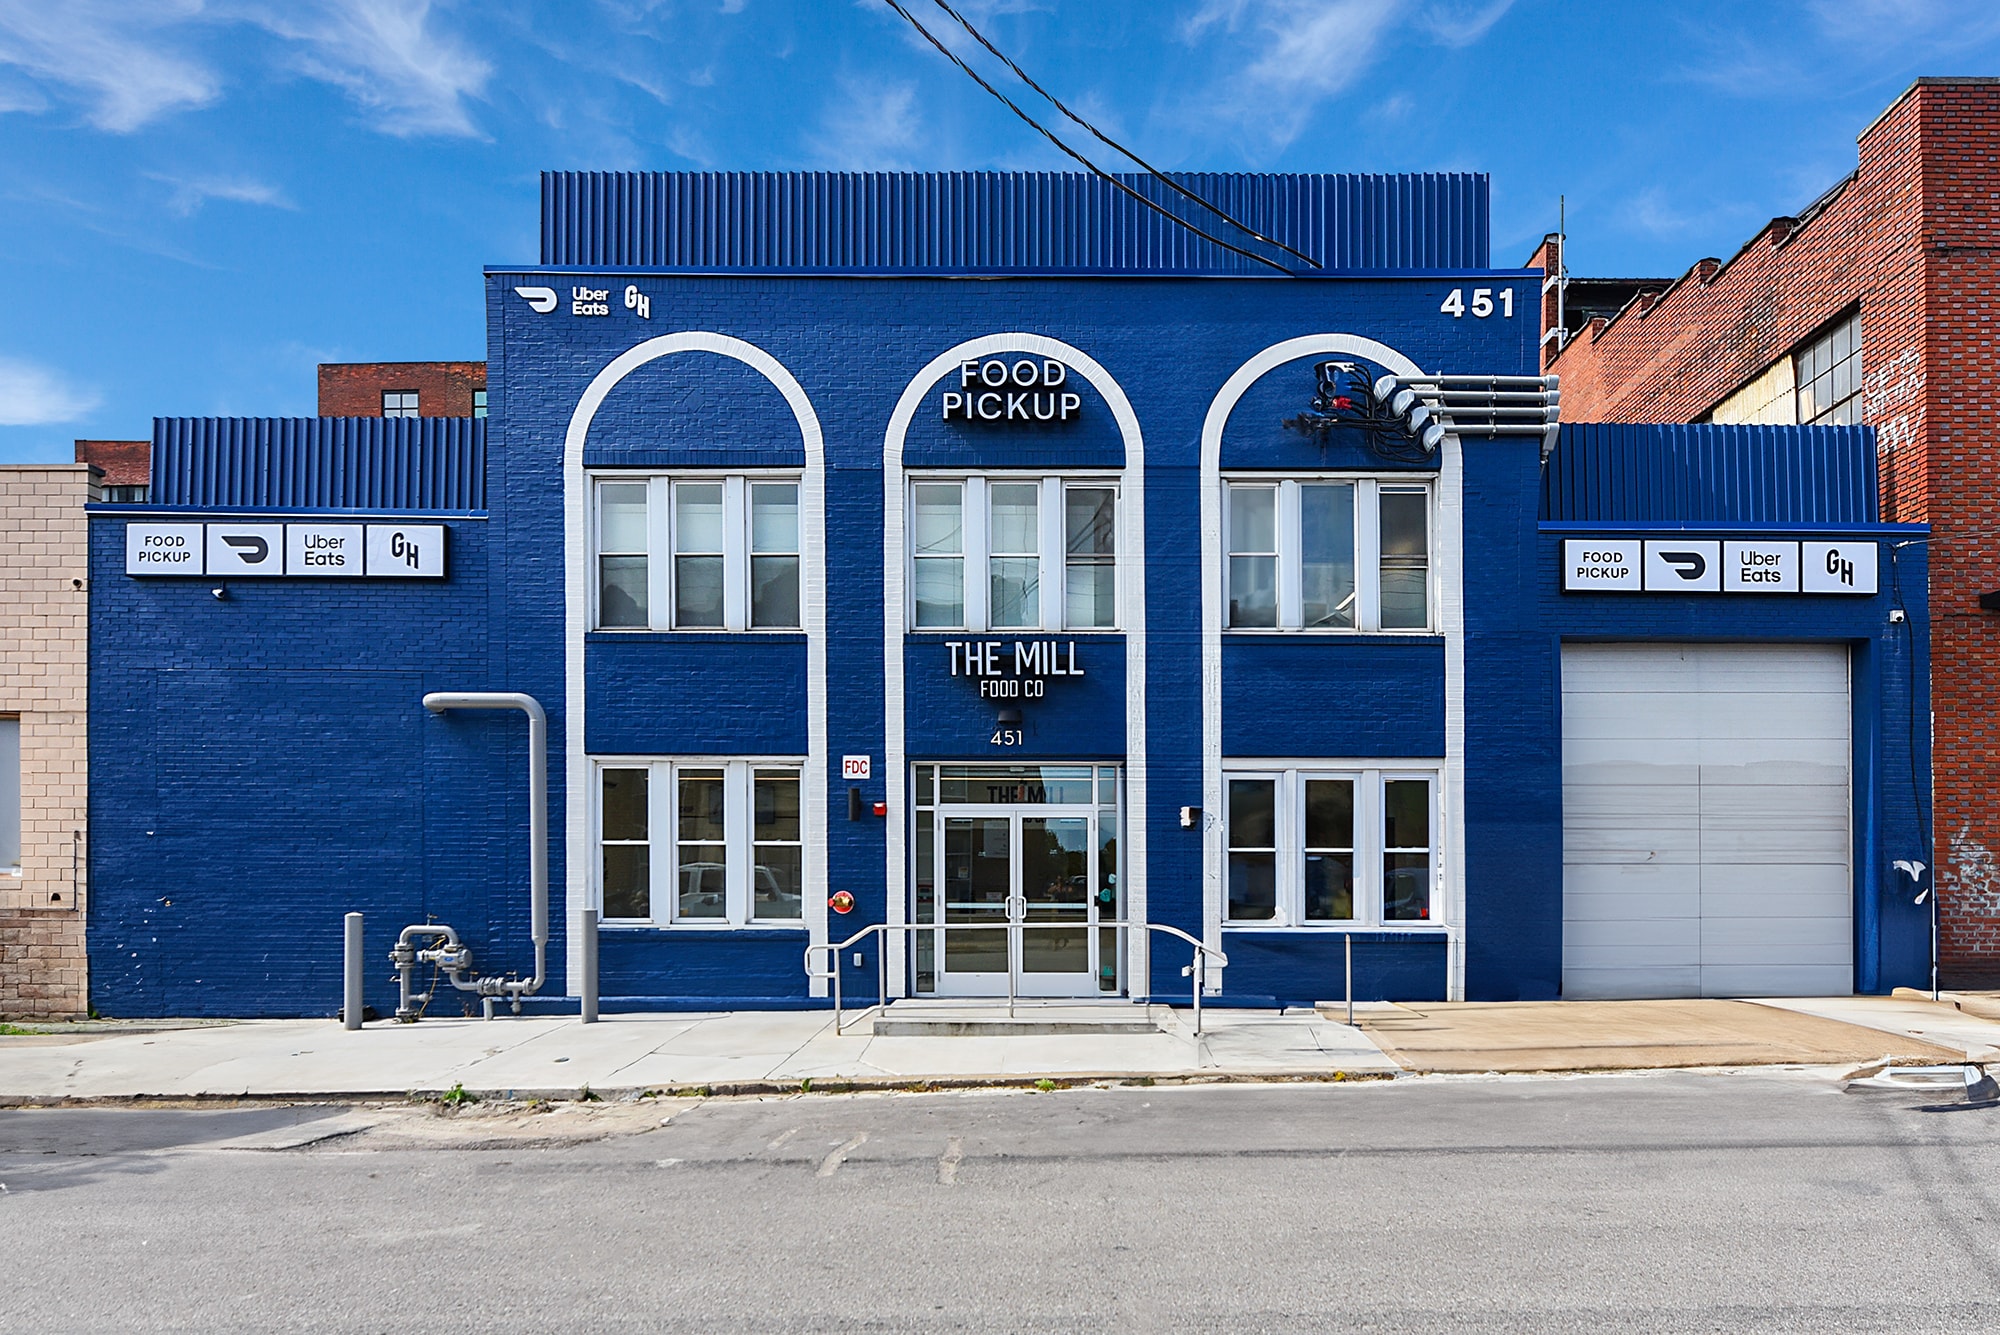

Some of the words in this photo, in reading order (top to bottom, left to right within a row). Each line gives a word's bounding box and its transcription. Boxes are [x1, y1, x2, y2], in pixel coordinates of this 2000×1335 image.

[572, 286, 609, 300] Uber
[572, 301, 609, 315] Eats
[1440, 288, 1513, 317] 451
[961, 360, 1066, 387] FOOD
[943, 392, 1081, 420] PICKUP
[145, 536, 185, 547] FOOD
[304, 534, 345, 549] Uber
[138, 551, 191, 563] PICKUP
[304, 552, 345, 566] Eats
[1583, 552, 1623, 563] FOOD
[1741, 551, 1781, 566] Uber
[1577, 567, 1629, 579] PICKUP
[1741, 568, 1781, 583] Eats
[945, 642, 1002, 675] THE
[1015, 641, 1084, 675] MILL
[980, 680, 1018, 697] FOOD
[1024, 680, 1044, 697] CO
[990, 730, 1022, 745] 451
[845, 760, 868, 774] FDC
